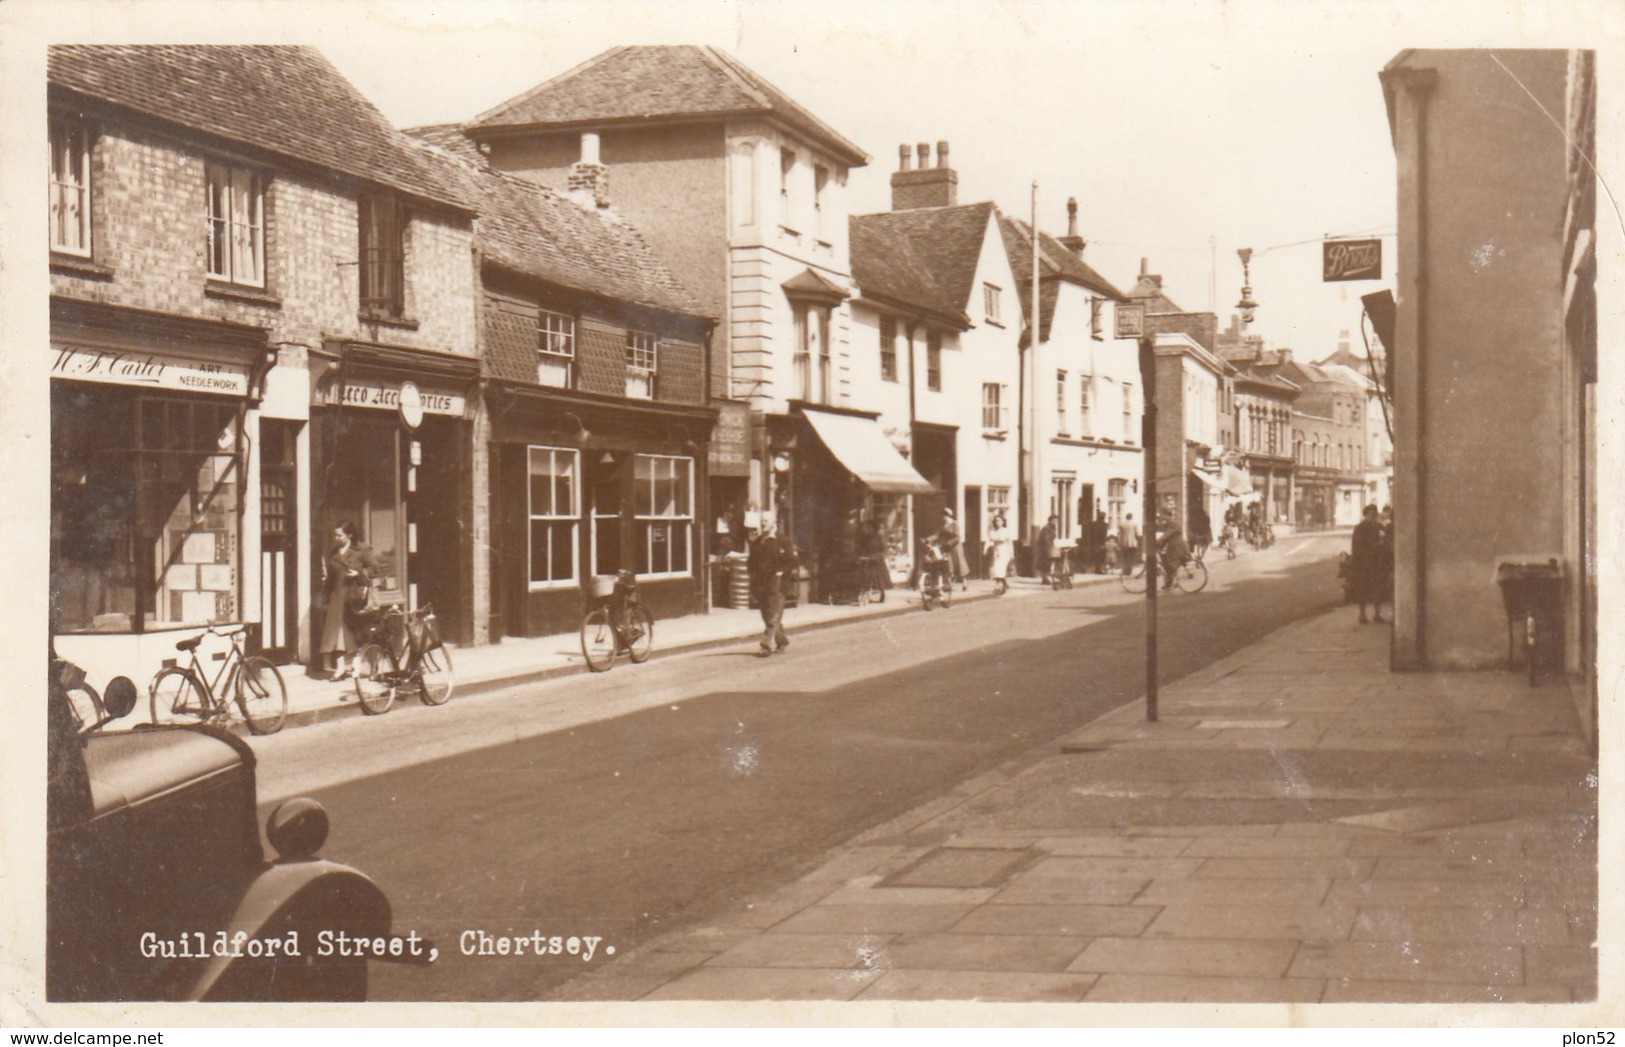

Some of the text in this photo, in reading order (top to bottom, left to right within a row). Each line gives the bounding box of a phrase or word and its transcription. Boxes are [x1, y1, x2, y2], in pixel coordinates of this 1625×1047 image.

[109, 352, 166, 377] Carter
[198, 362, 222, 375] ART
[179, 375, 239, 391] NEEDLEWORK
